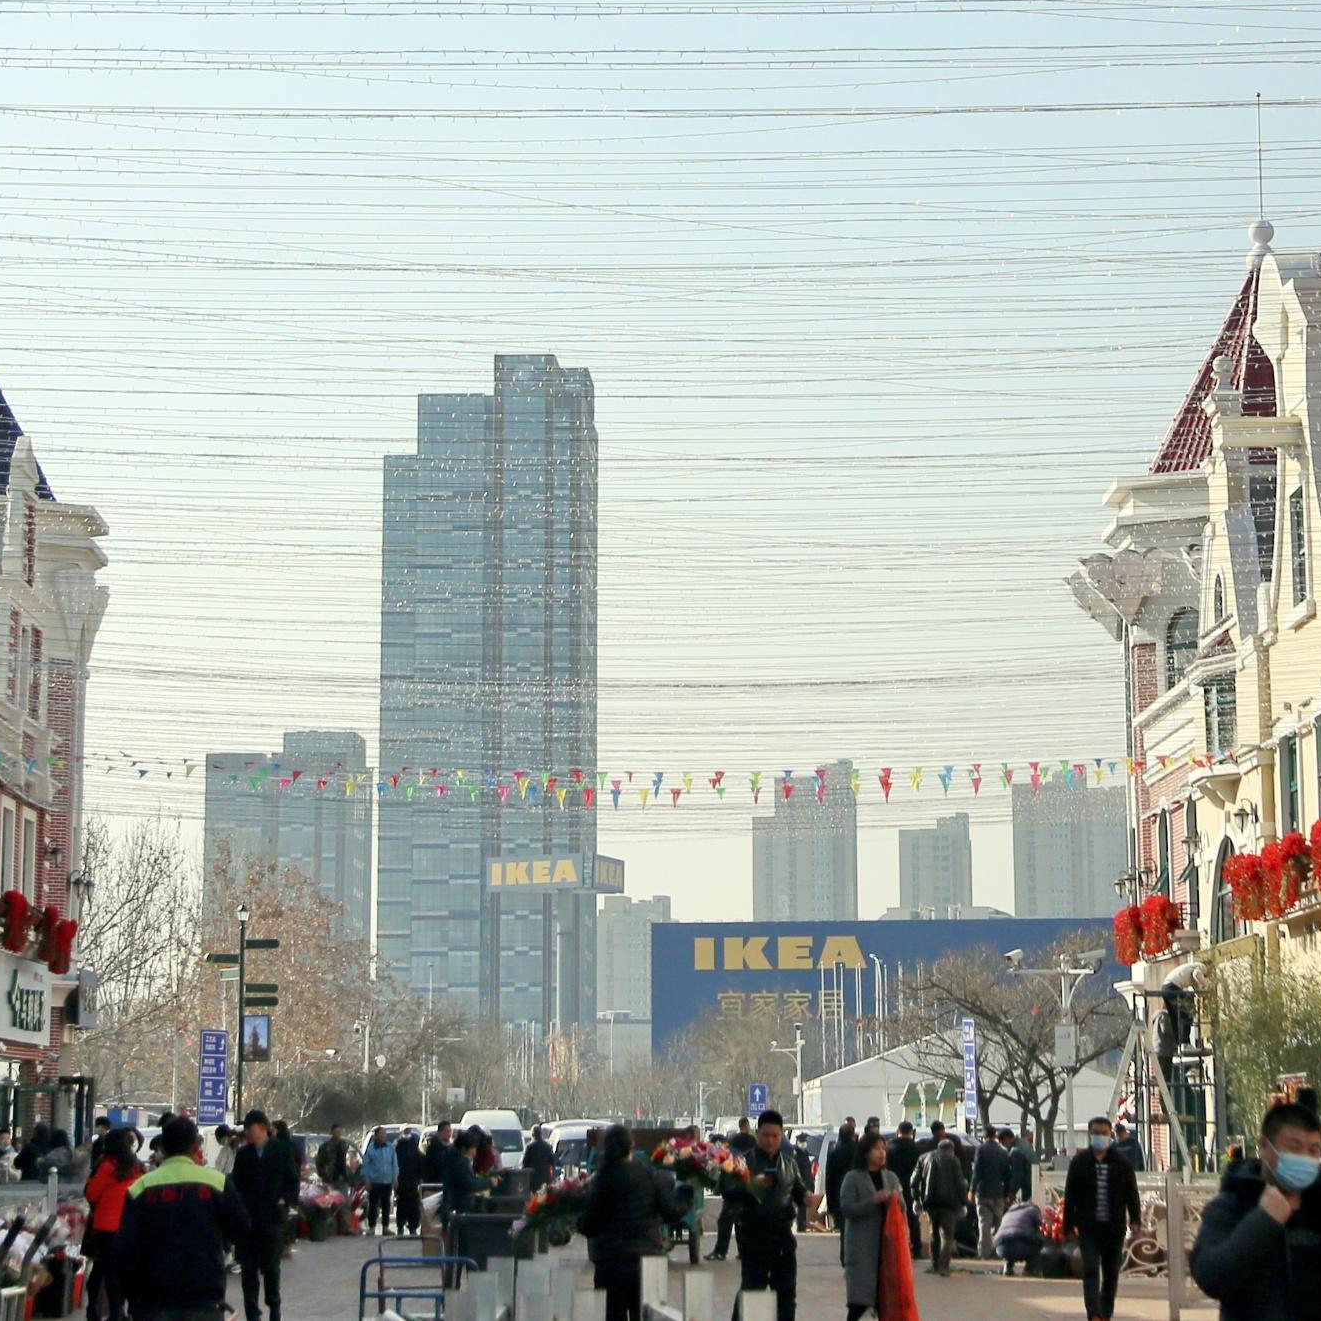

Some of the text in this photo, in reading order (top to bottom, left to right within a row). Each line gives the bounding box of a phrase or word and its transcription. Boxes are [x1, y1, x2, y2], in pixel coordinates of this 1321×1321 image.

[491, 859, 577, 886] IKEA
[694, 936, 870, 970] IKEA
[717, 989, 846, 1020] 宜家家居
